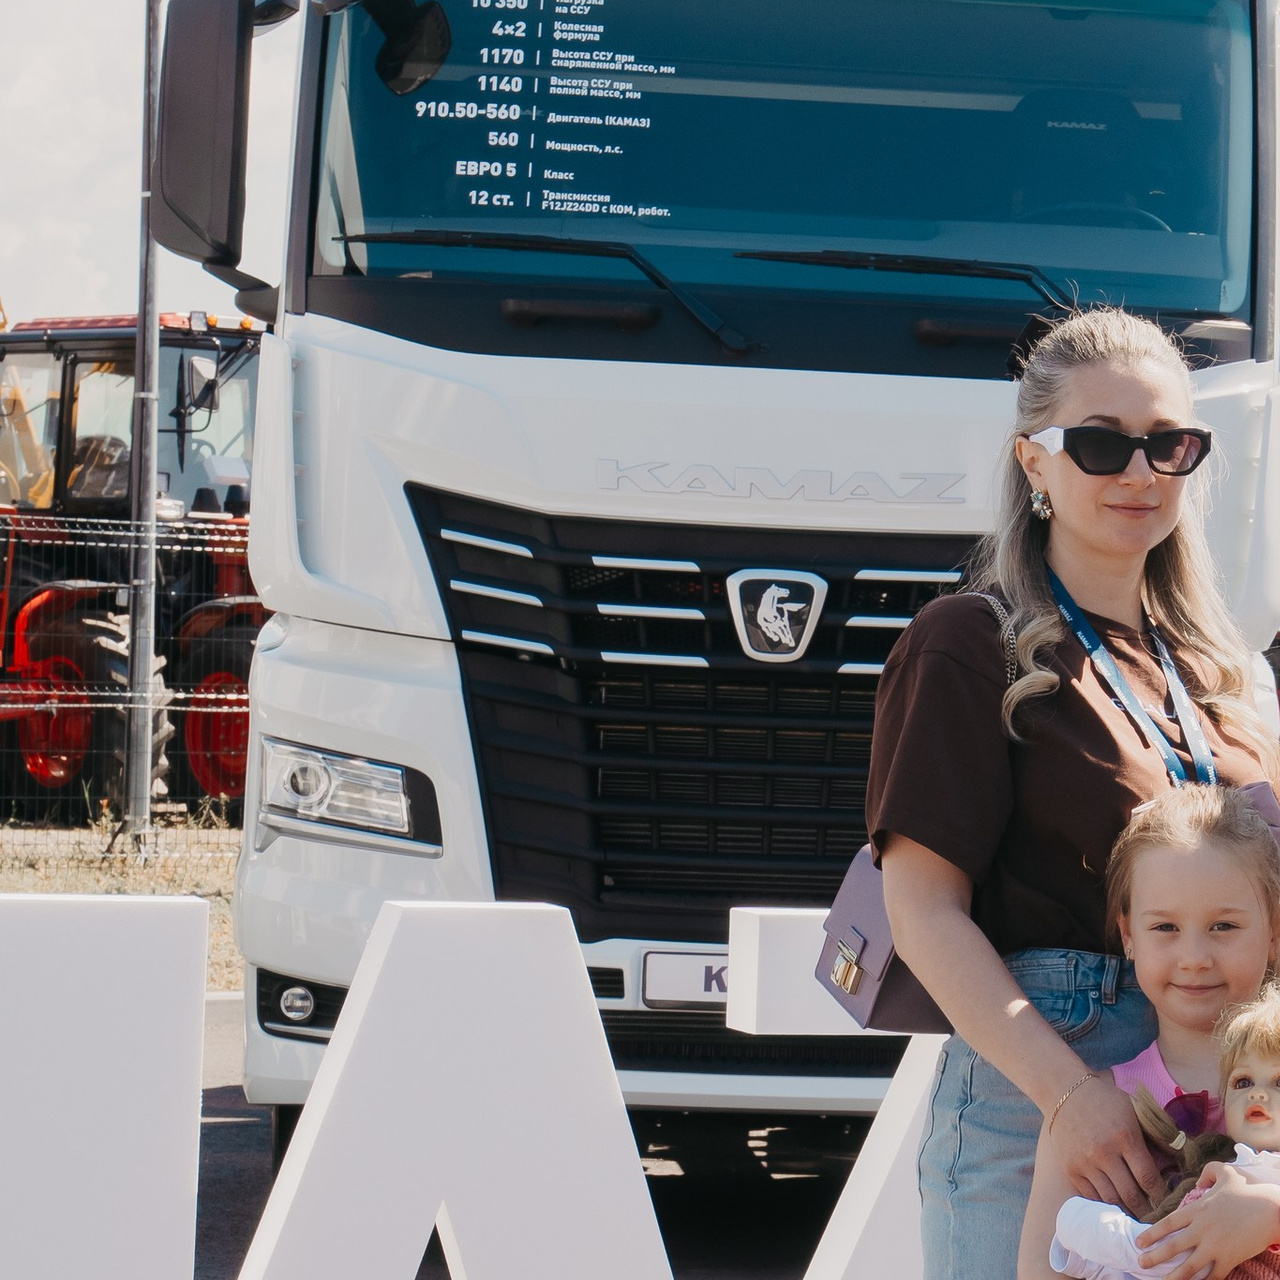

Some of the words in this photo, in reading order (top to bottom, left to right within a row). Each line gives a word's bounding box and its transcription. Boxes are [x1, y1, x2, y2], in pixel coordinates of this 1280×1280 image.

[555, 6, 566, 14] на
[570, 5, 591, 15] ССУ
[554, 21, 604, 32] Колесная
[553, 30, 600, 42] формула
[480, 48, 524, 65] 1170
[552, 49, 591, 60] Высота
[592, 51, 613, 61] ССУ
[615, 54, 634, 64] при
[551, 58, 622, 70] снаряженной
[624, 63, 658, 74] массе,
[659, 66, 675, 74] мм
[478, 75, 522, 92] 1140
[550, 76, 589, 88] Высота
[591, 79, 611, 88] ССУ
[613, 82, 633, 91] при
[549, 86, 588, 96] полной
[590, 89, 623, 99] массе,
[625, 91, 641, 99] мм
[415, 101, 520, 120] 910.50-560
[547, 112, 603, 124] Двигатель
[605, 115, 650, 128] (КАМАЗ)
[1047, 121, 1107, 130] KAMAZ
[488, 132, 518, 146] 560
[546, 140, 603, 154] Мощность,
[604, 146, 623, 154] л.с.
[455, 161, 502, 176] ЕВРО
[506, 162, 516, 177] 5
[544, 169, 574, 180] Класс
[469, 190, 489, 205] 12
[492, 194, 514, 206] ст.
[542, 190, 610, 202] Трансмиссия
[609, 204, 636, 216] КОМ,
[638, 206, 671, 217] робот.
[597, 458, 967, 503] KAMAZ
[1076, 631, 1092, 649] KAMAZ
[703, 965, 728, 993] K
